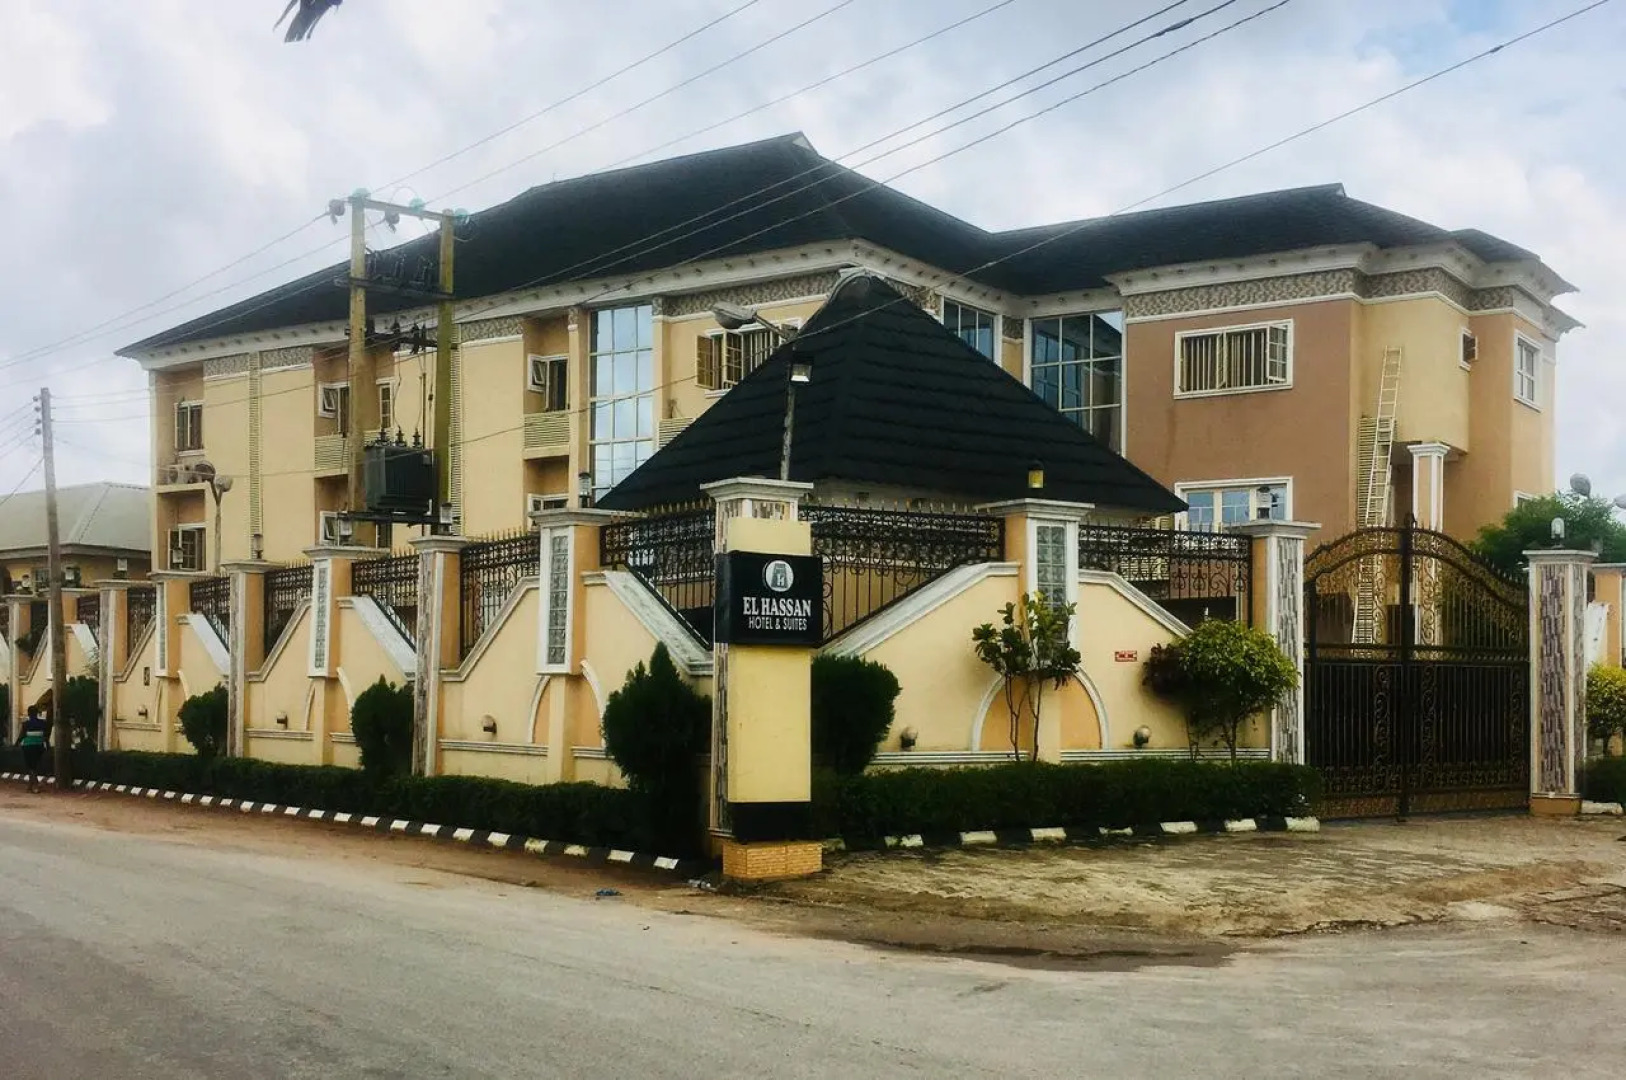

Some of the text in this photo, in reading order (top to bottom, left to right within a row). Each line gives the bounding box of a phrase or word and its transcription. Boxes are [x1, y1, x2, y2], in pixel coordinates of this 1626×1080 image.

[743, 596, 811, 617] EL HASSAN
[748, 616, 807, 631] HOTEL & SUITES
